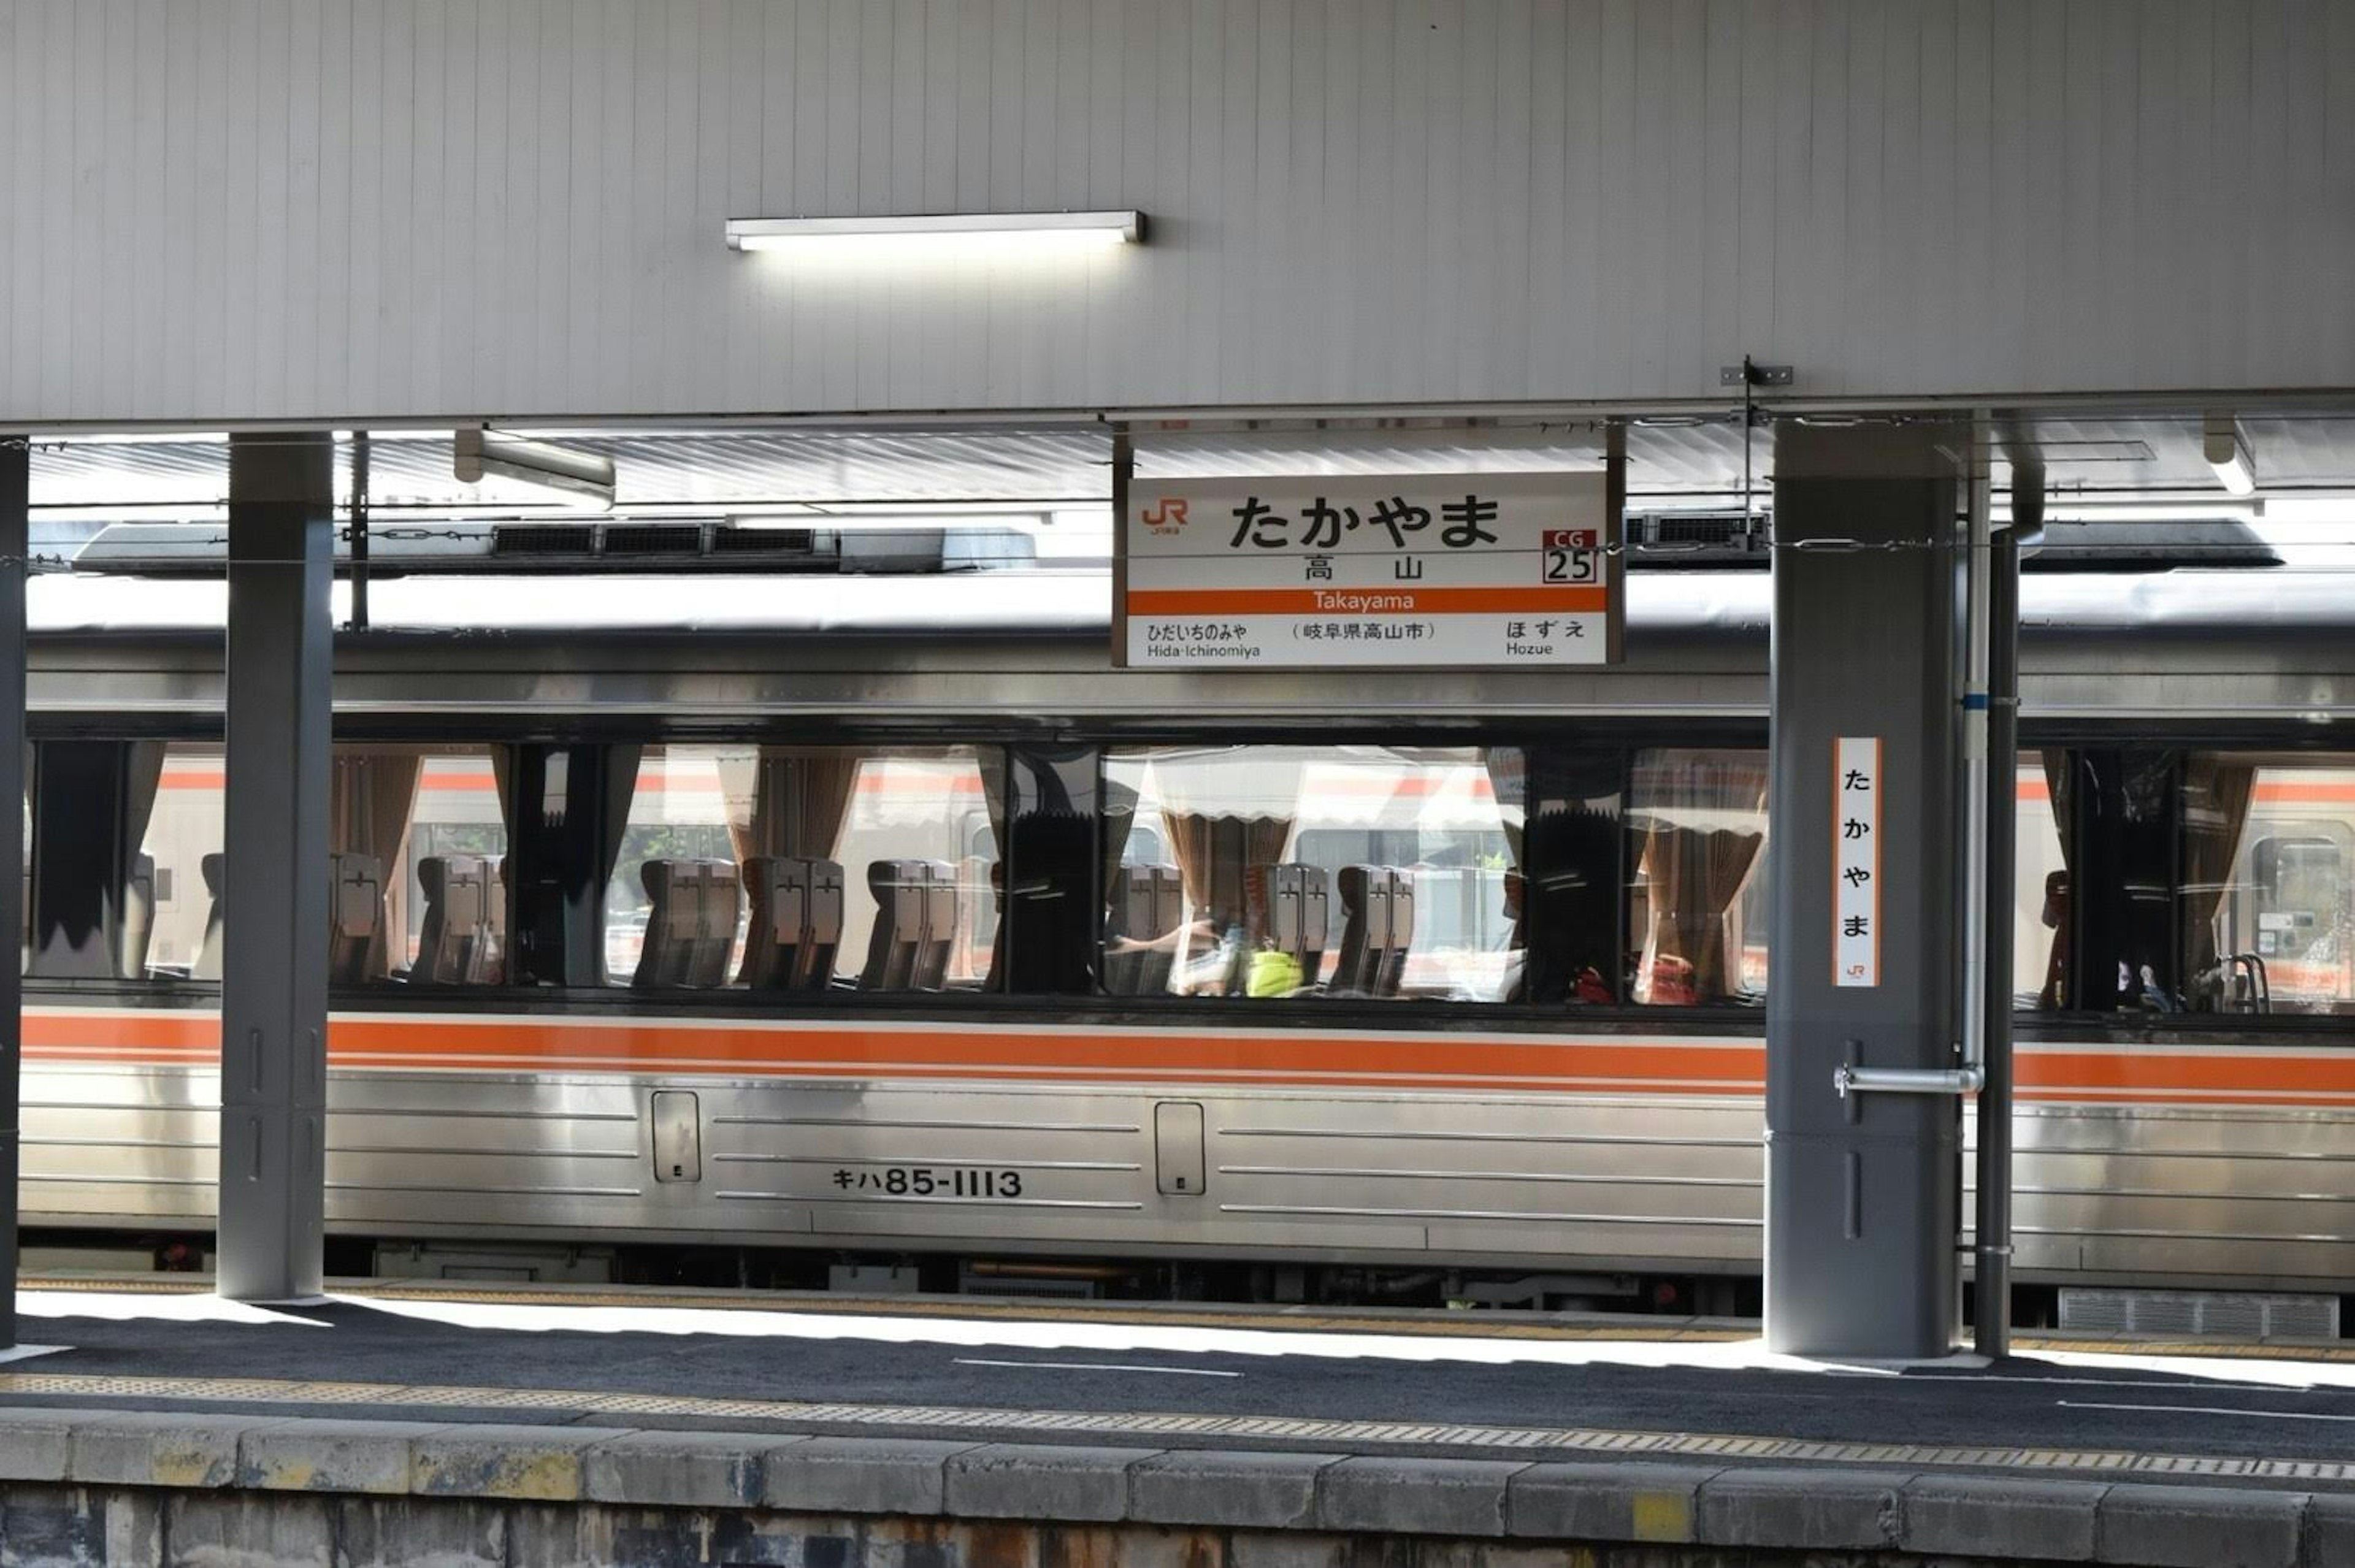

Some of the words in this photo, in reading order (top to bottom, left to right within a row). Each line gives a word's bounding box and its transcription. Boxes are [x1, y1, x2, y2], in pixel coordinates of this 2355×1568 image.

[1142, 499, 1189, 526] JR
[1230, 495, 1498, 548] たかやま
[1555, 531, 1584, 548] CG
[1303, 554, 1422, 580] 高山
[1549, 549, 1591, 579] 25
[1314, 591, 1414, 613] Takayama
[1147, 624, 1247, 641] ひだいちのみや
[1507, 620, 1584, 638] ほずえ
[1507, 643, 1553, 655] Hozue
[1844, 769, 1870, 936] たかやま
[1847, 965, 1864, 975] JR
[833, 1169, 1022, 1198] キハ85-1113
